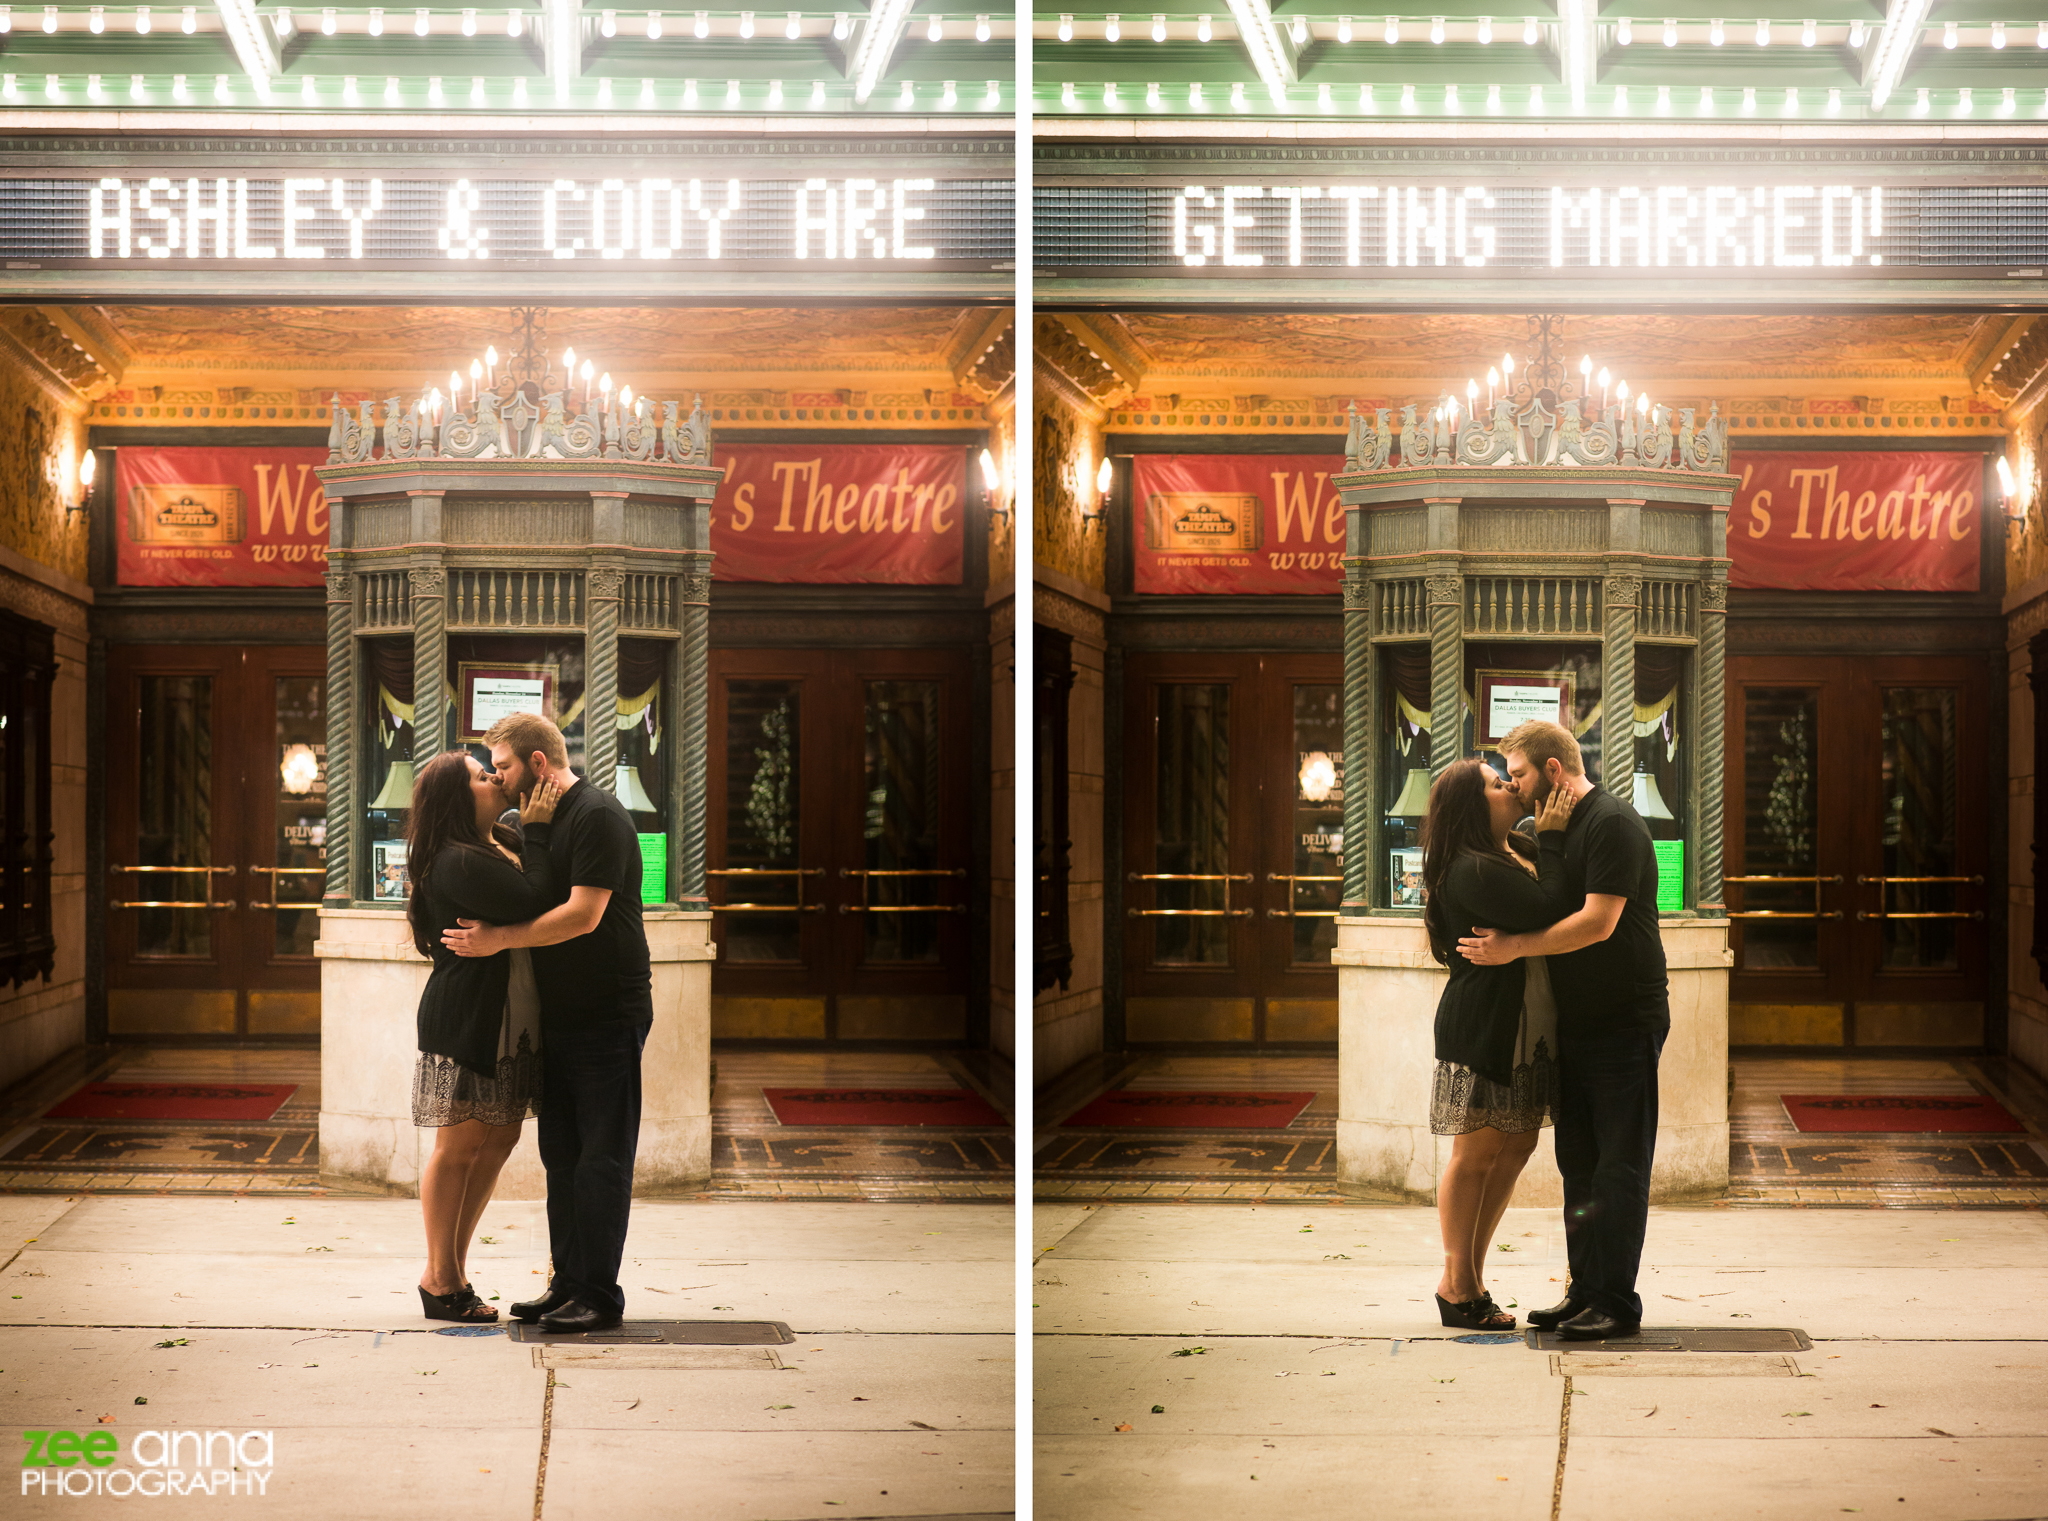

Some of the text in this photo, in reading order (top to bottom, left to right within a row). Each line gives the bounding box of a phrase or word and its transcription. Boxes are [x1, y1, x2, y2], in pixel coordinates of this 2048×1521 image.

[90, 178, 935, 259] ASHLEY & CODY ARE
[1174, 186, 1495, 266] GETTING
[772, 457, 957, 534] Theatre
[1789, 465, 1974, 541] Theatre
[159, 514, 215, 524] THEATRE
[1187, 513, 1221, 522] TAMPA
[1176, 522, 1232, 532] THEATRE
[140, 549, 149, 558] IT
[151, 549, 183, 558] NEVER
[184, 549, 210, 558] GETS
[1157, 557, 1167, 566] IT
[1168, 557, 1200, 566] NEVER
[1201, 557, 1228, 567] GETS
